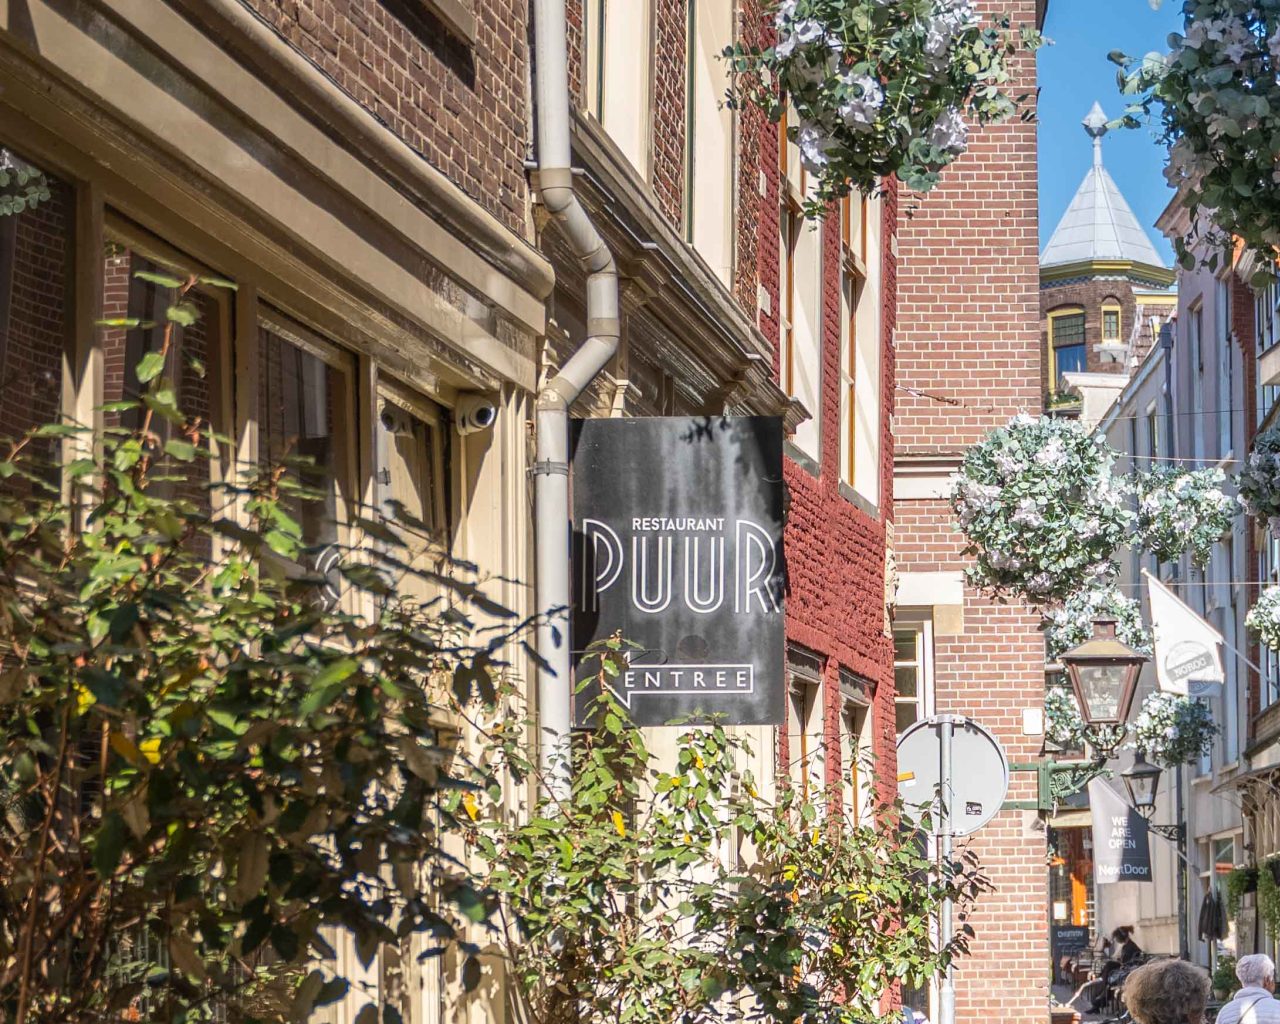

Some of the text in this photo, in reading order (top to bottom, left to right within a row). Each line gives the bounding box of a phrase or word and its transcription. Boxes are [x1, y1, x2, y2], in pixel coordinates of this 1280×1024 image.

[632, 517, 725, 531] RESTAURANT
[582, 518, 781, 614] PUUR
[624, 671, 748, 688] ENTREE
[1111, 816, 1128, 826] WE
[1111, 827, 1132, 837] ARE
[1108, 839, 1137, 849] OPEN
[1098, 863, 1149, 875] NextDoor
